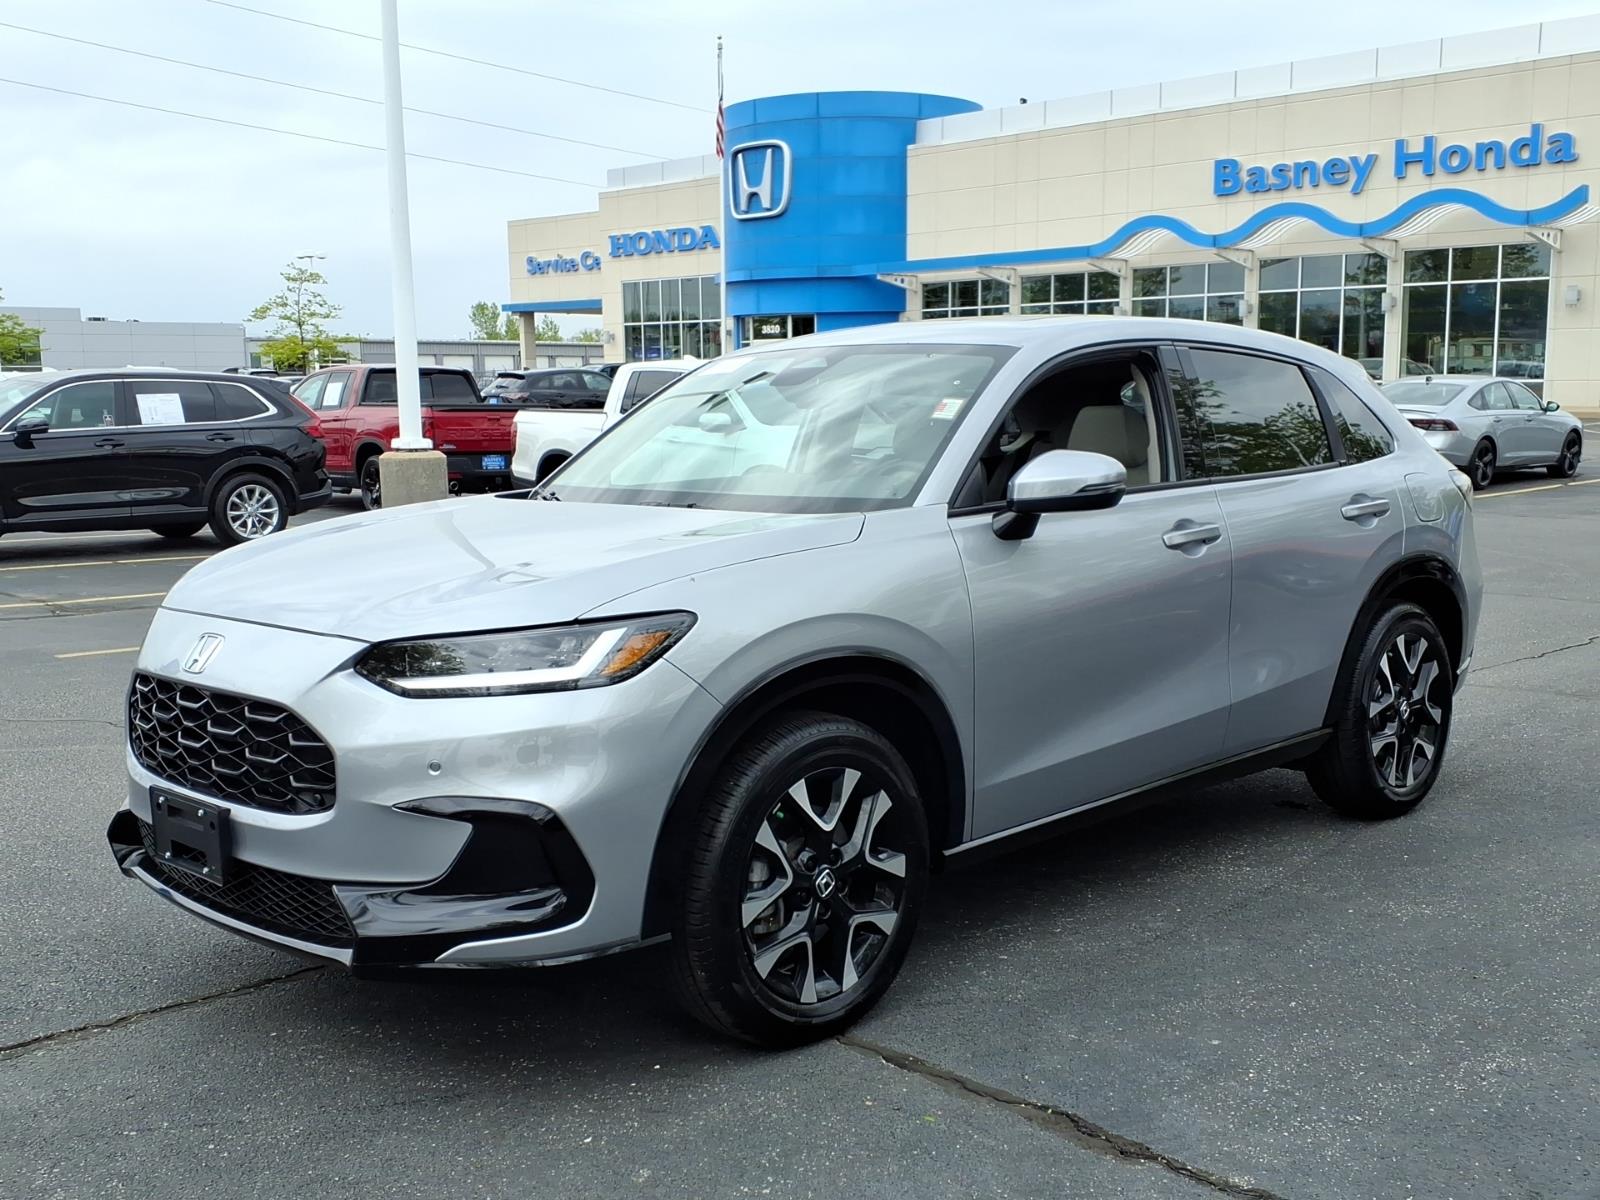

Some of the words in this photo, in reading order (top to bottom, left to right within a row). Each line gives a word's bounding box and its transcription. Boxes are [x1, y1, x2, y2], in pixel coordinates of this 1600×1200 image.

[1213, 154, 1378, 197] Basney
[1394, 122, 1578, 179] Honda
[608, 225, 721, 258] HONDA
[526, 254, 579, 276] Service
